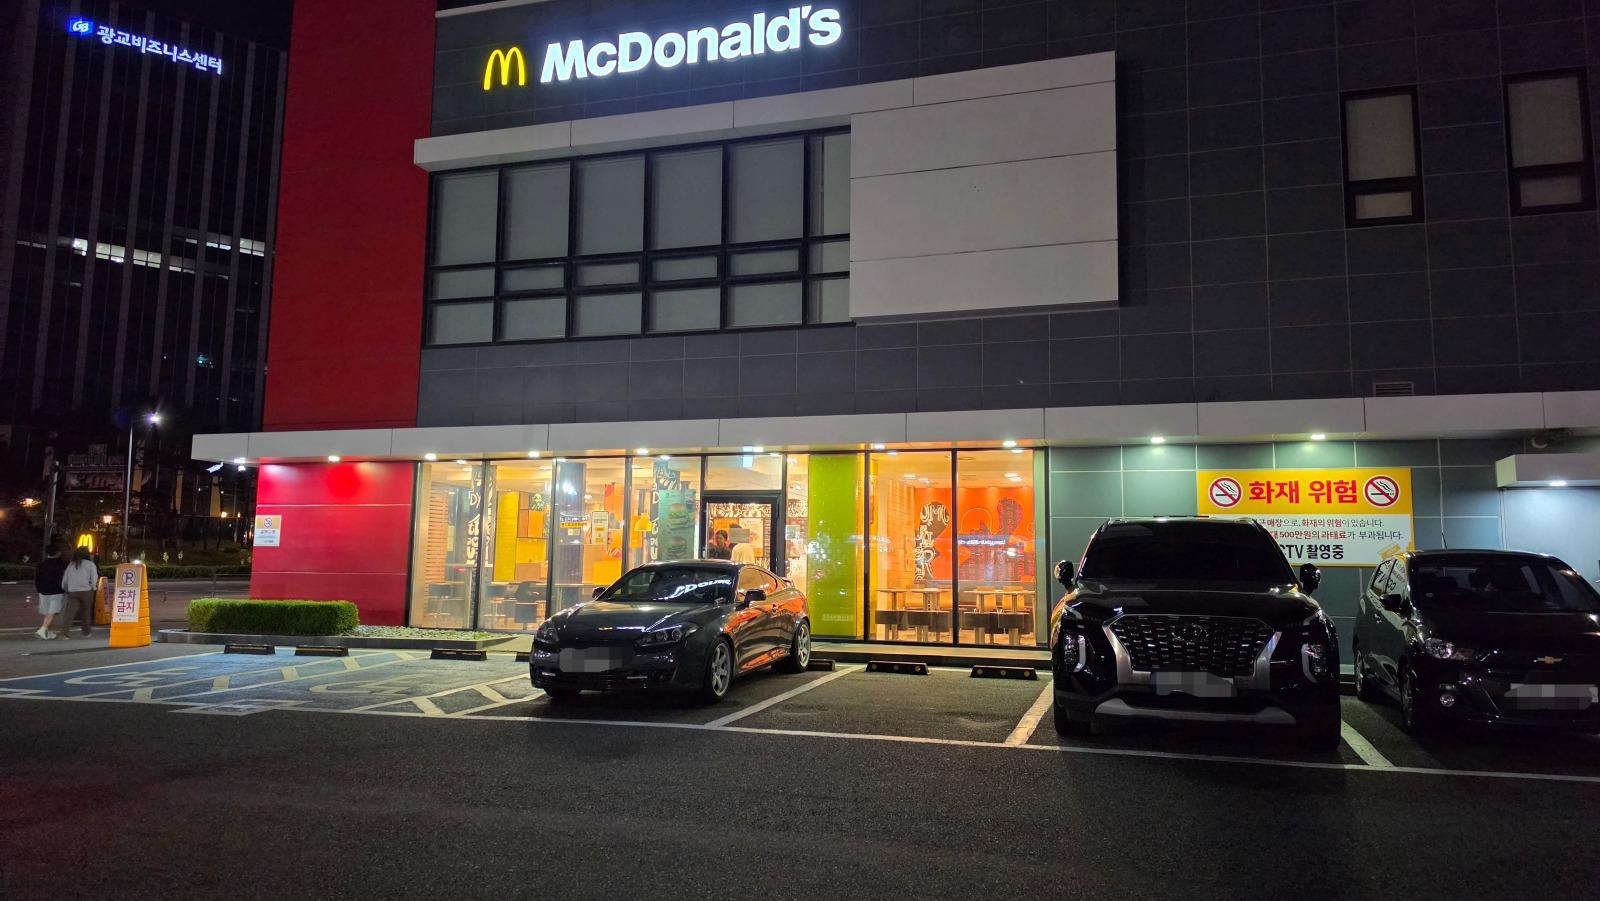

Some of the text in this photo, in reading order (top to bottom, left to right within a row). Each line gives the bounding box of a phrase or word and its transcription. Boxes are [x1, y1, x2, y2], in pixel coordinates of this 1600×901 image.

[97, 25, 222, 75] 광교비즈니스센터
[540, 5, 842, 83] McDonald's
[1248, 480, 1358, 504] 화재 위험
[1302, 518, 1325, 528] 화재의
[1327, 518, 1350, 528] 위험이
[1280, 531, 1320, 540] 500만원의
[1321, 530, 1354, 540] 과태료가
[1359, 530, 1404, 540] 부과됩니다.
[1306, 544, 1344, 560] 촬영중
[118, 589, 136, 602] 주차
[117, 601, 135, 613] 금지
